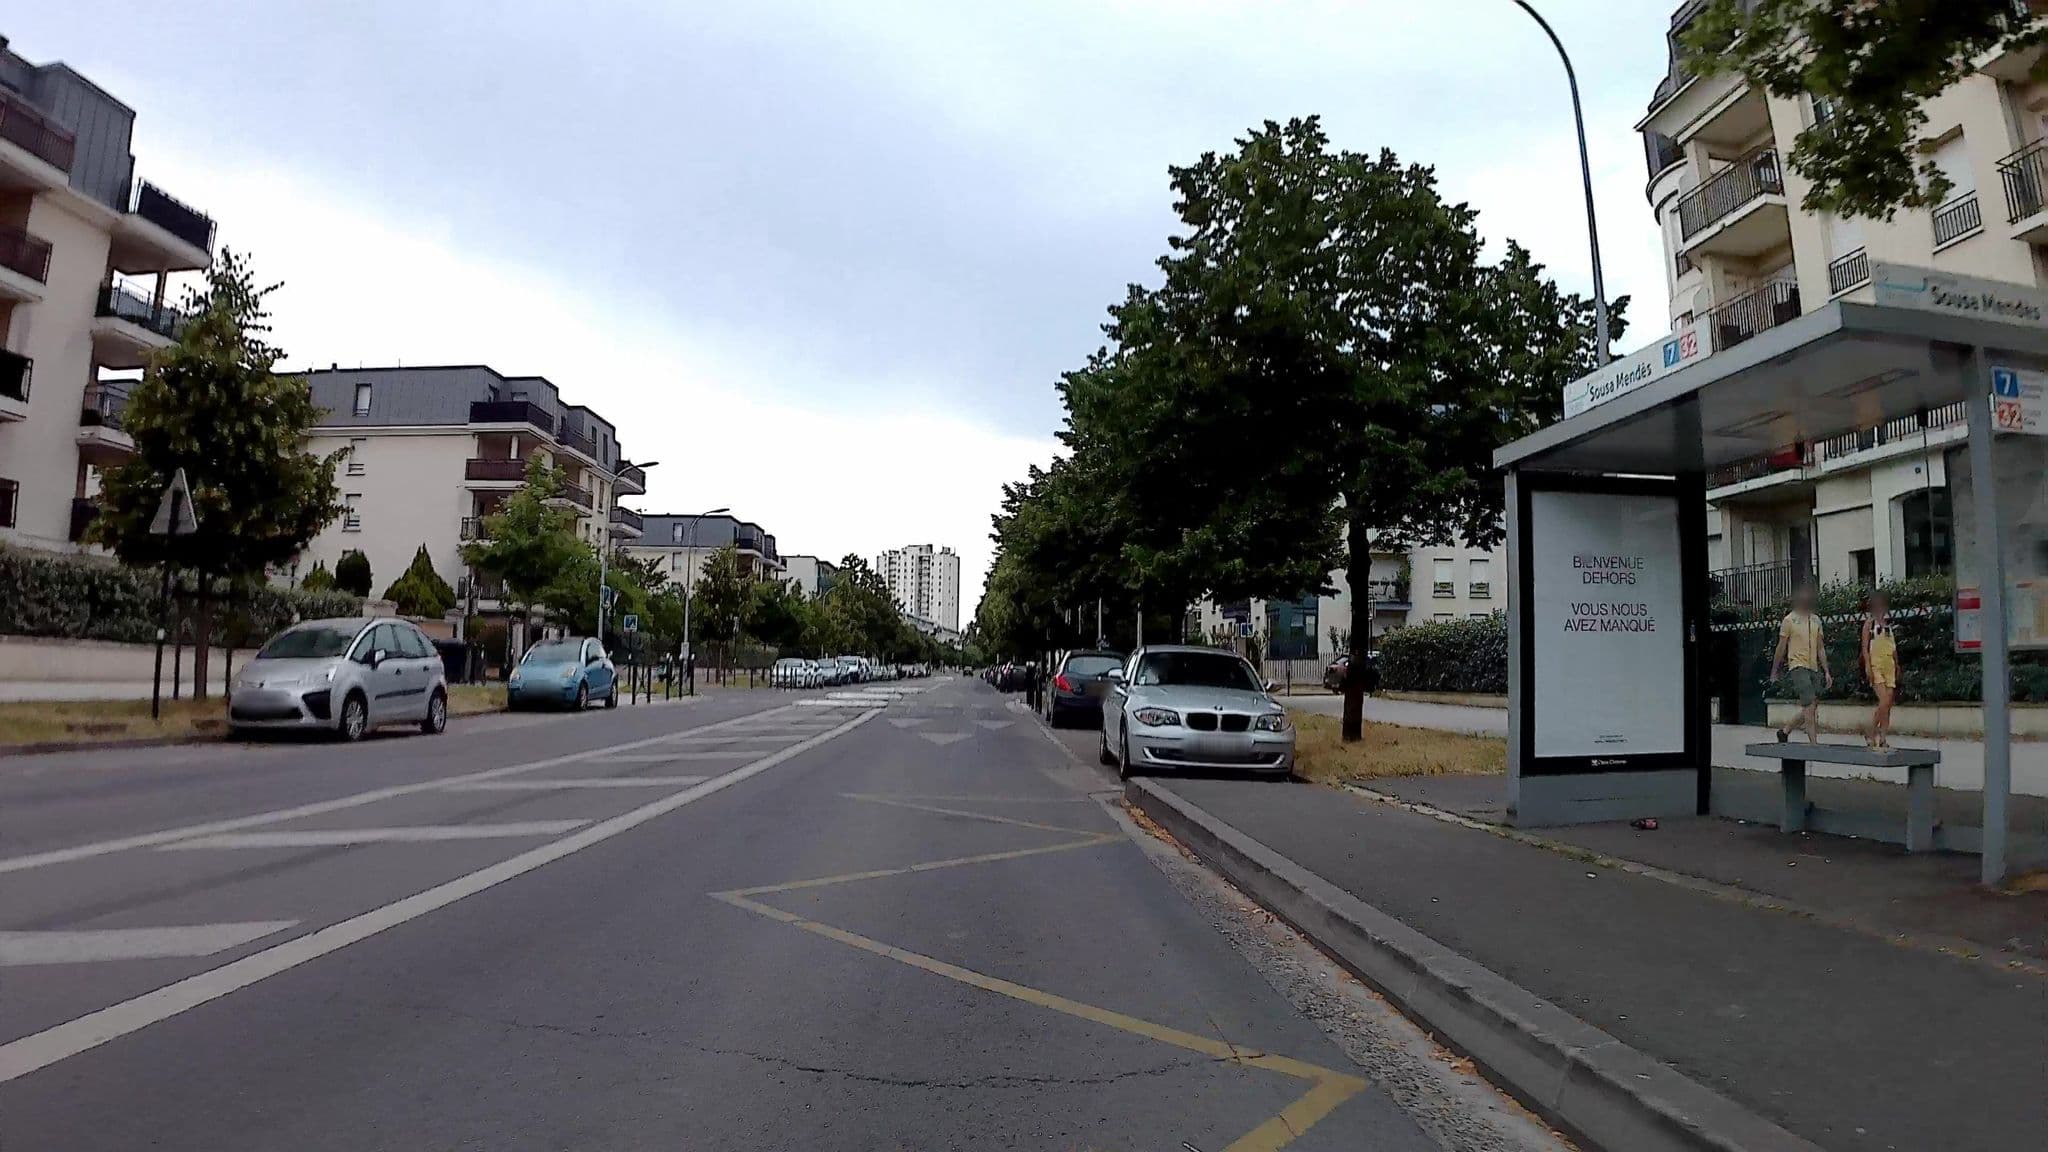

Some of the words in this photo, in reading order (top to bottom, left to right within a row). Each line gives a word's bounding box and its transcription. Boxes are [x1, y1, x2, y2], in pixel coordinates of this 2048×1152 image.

[1589, 378, 1615, 402] Sousa
[1615, 361, 1652, 389] Mendès
[1999, 373, 2011, 395] 7
[1582, 571, 1637, 585] DEHORS
[1571, 602, 1609, 616] VOUS
[1611, 603, 1648, 617] NOUS
[1563, 618, 1598, 632] AVEZ
[1600, 616, 1656, 632] MANQUÉ
